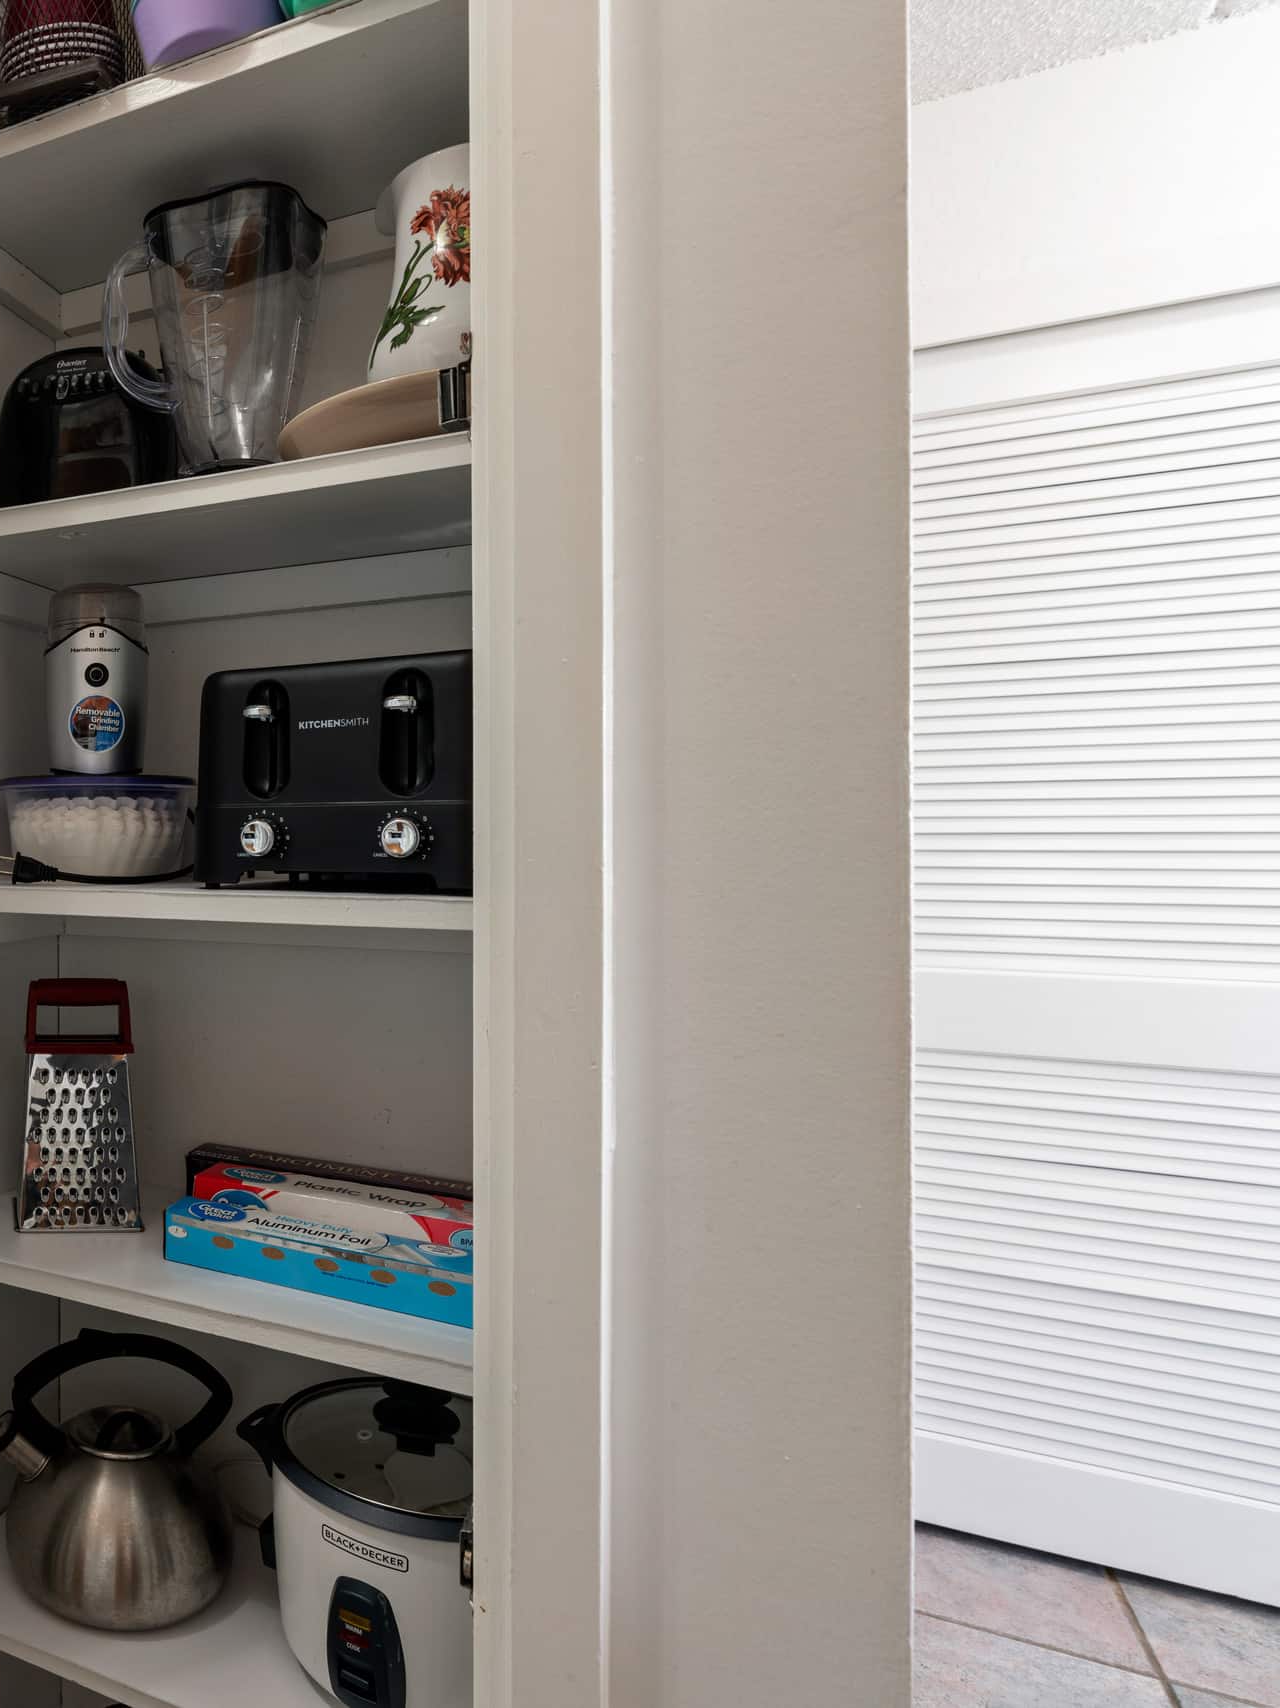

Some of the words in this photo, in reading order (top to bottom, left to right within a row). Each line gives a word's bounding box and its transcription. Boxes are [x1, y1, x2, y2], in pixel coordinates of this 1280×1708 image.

[75, 706, 121, 718] Removable
[88, 723, 120, 732] Chamber
[91, 716, 120, 726] Grinding
[298, 717, 369, 730] KITCHENSMITH
[248, 1152, 392, 1179] PARCHMENT
[293, 1180, 361, 1197] Plastic
[368, 1193, 427, 1208] Wrap
[198, 1203, 238, 1217] Great
[204, 1211, 233, 1220] Value
[247, 1217, 336, 1240] Aluminum
[338, 1233, 372, 1246] Foil
[275, 1215, 314, 1228] Heavy
[321, 1223, 353, 1234] Duty
[324, 1528, 405, 1568] BLACK+DECKER
